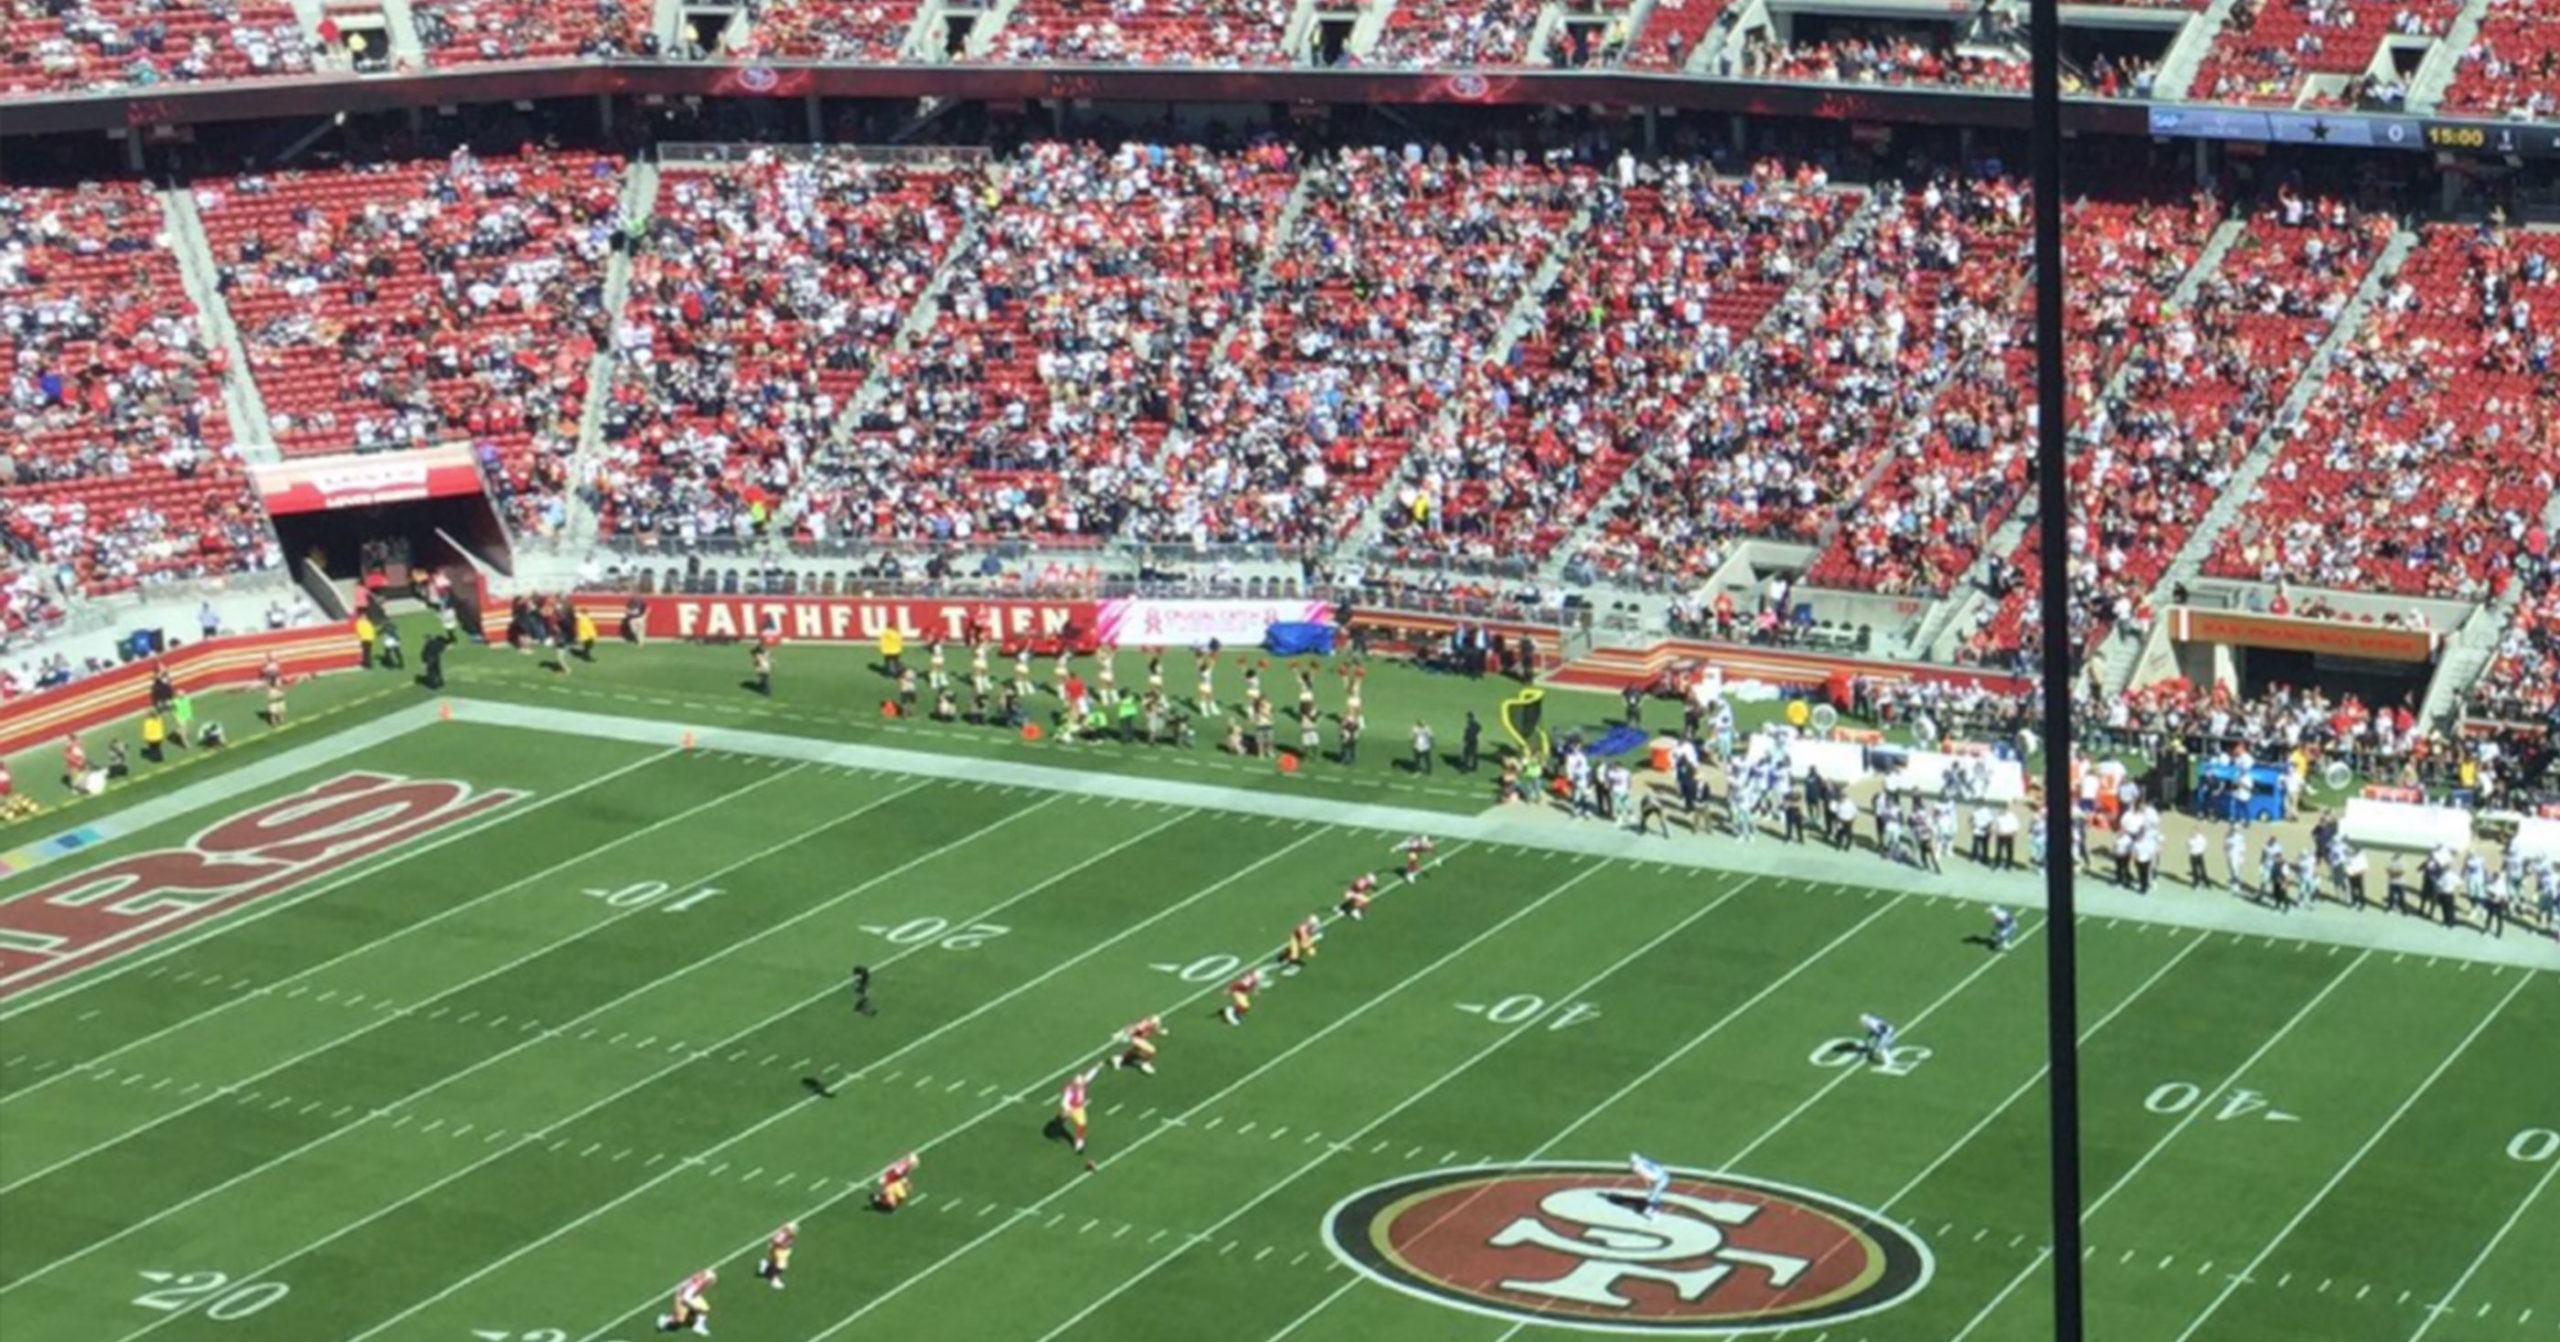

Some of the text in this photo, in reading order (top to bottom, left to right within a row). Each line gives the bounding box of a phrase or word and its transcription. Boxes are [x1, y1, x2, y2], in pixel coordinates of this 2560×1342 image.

[2387, 123, 2405, 142] 0
[2429, 127, 2484, 147] 15:00
[676, 603, 922, 638] FAITHFUL
[606, 880, 726, 912] 10
[886, 917, 1012, 951] 20
[1486, 994, 1602, 1032] 40
[2143, 1082, 2268, 1122] 40
[131, 1271, 290, 1320] 20
